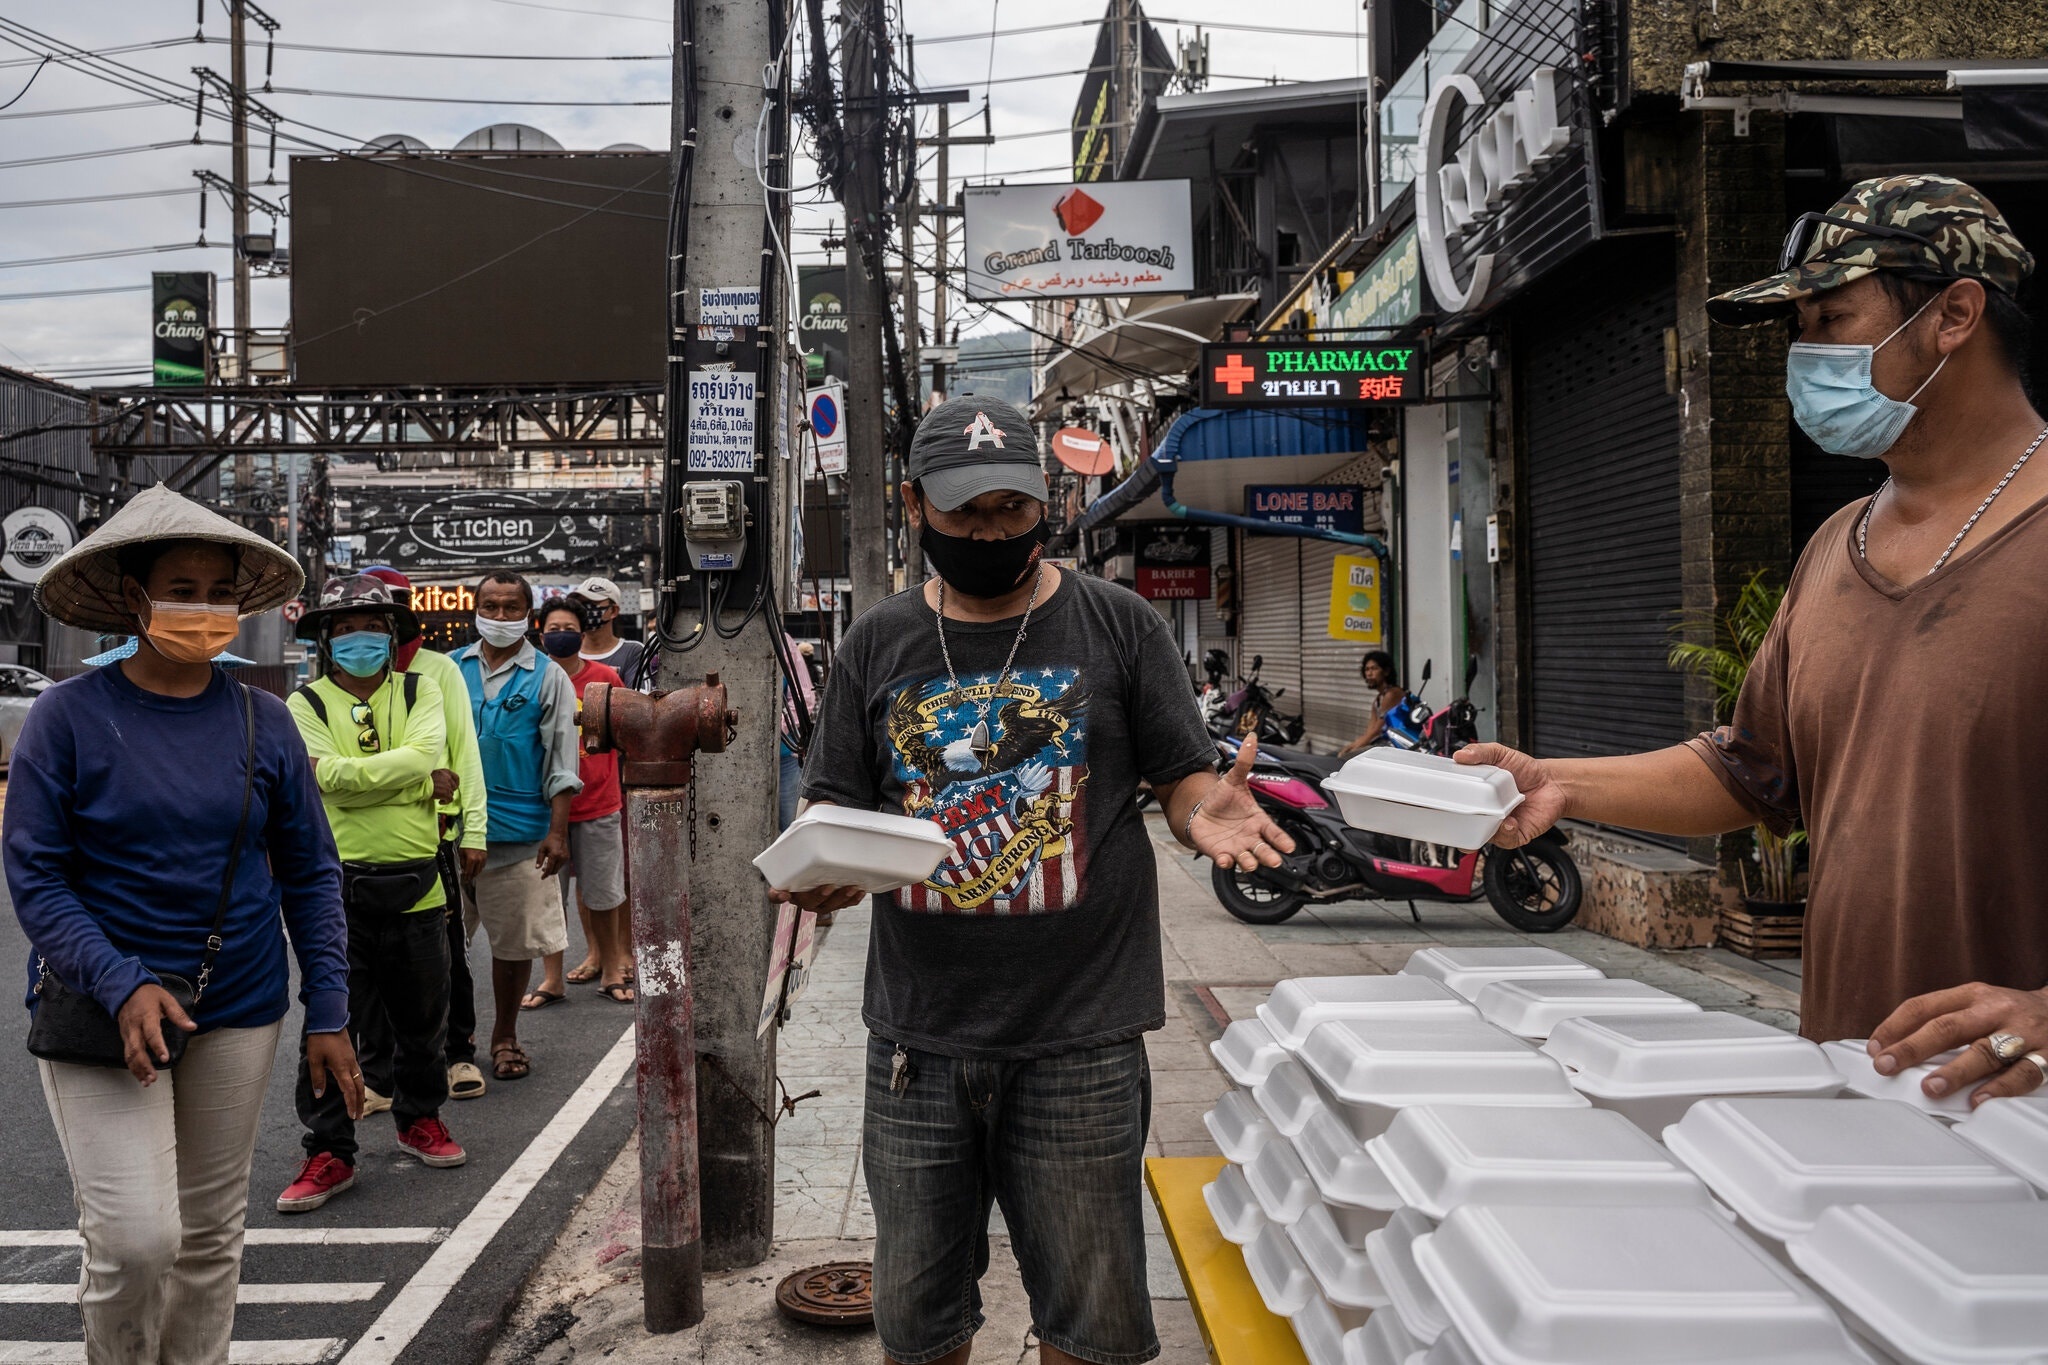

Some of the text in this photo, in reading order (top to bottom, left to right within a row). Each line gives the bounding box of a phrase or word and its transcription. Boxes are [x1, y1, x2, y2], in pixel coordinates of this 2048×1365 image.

[984, 237, 1175, 275] Grand Tarboosh
[1000, 276, 1032, 292] عربي
[1037, 271, 1084, 290] ومرقص
[1132, 269, 1162, 285] مطعم
[154, 321, 205, 341] Chang
[801, 314, 848, 333] Chang
[1266, 350, 1413, 373] PHARMACY
[692, 374, 754, 400] รถรับจ้าง
[1261, 379, 1341, 397] ขายยา
[1358, 375, 1404, 400] 药店
[699, 400, 745, 417] ทั่วไทย
[967, 413, 1005, 451] A
[689, 449, 752, 469] 092-5283774
[1255, 491, 1354, 512] LONE BAR
[1283, 515, 1303, 523] BEER
[9, 538, 30, 550] Pizza
[1151, 569, 1196, 580] BARBER
[1350, 566, 1374, 586] เปิด
[1152, 587, 1195, 597] TATTOO
[1345, 617, 1373, 631] Open
[1035, 709, 1063, 723] 1775
[897, 723, 925, 746] SINCE
[956, 824, 1052, 903] ARMY STRONG
